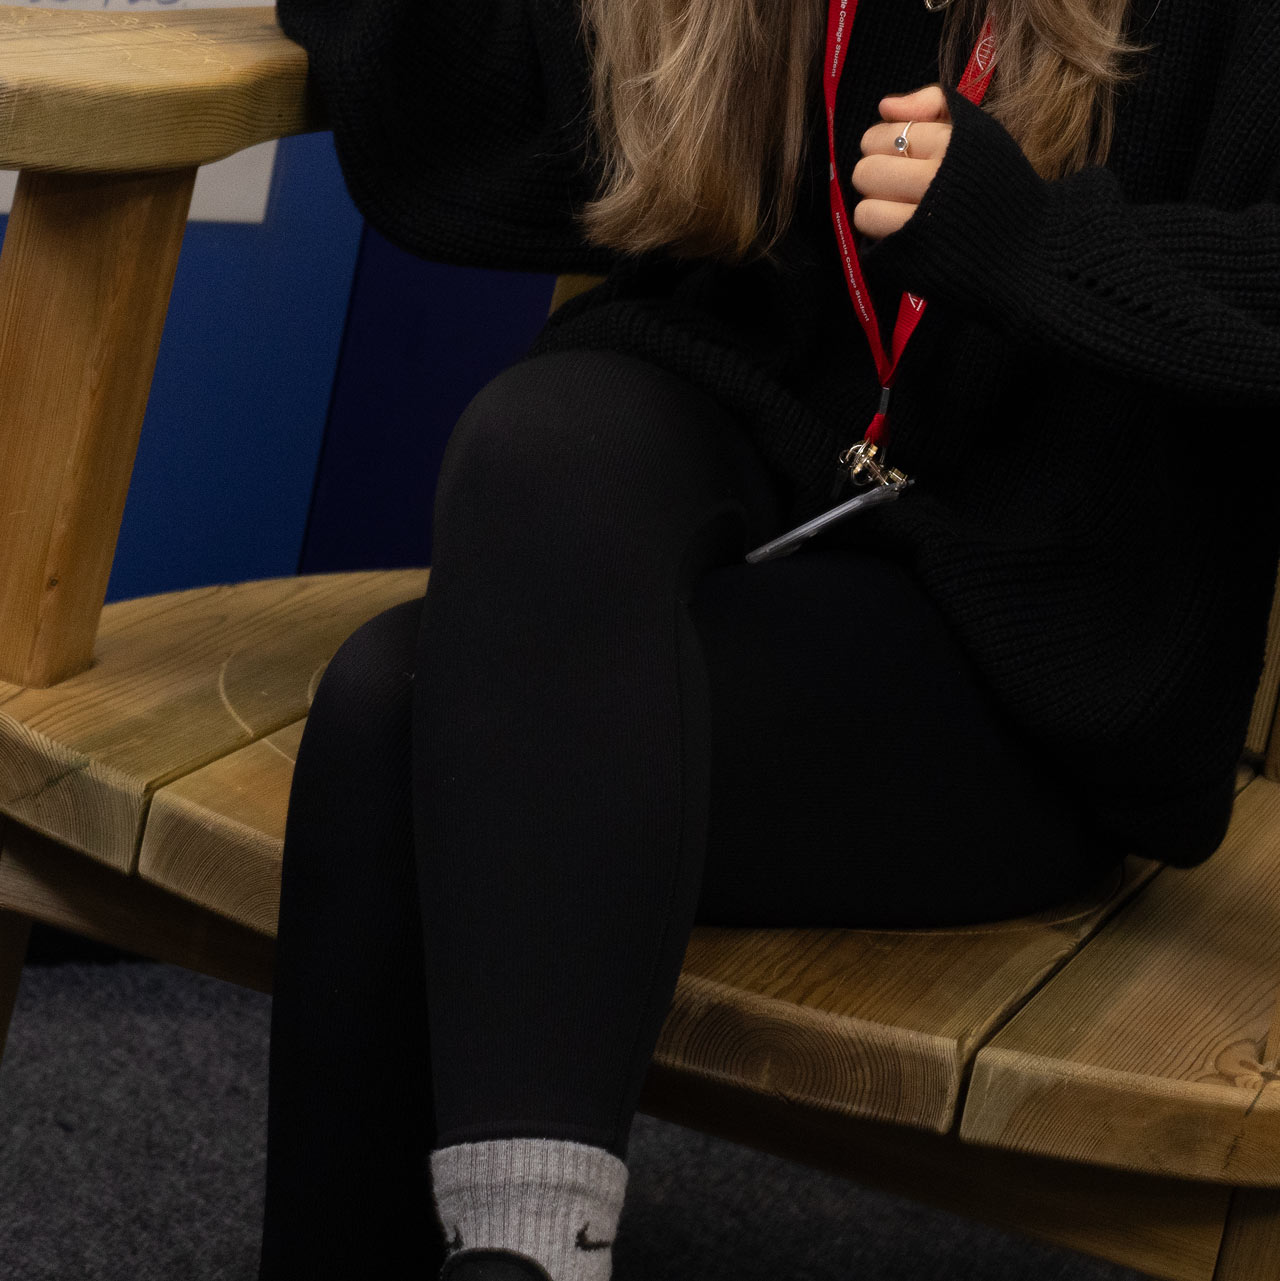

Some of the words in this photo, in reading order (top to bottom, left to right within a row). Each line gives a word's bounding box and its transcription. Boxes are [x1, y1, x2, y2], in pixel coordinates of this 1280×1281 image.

[834, 10, 849, 44] College
[829, 43, 843, 78] Student
[833, 211, 850, 256] Newcastle
[844, 256, 858, 289] College
[853, 288, 871, 323] Student
